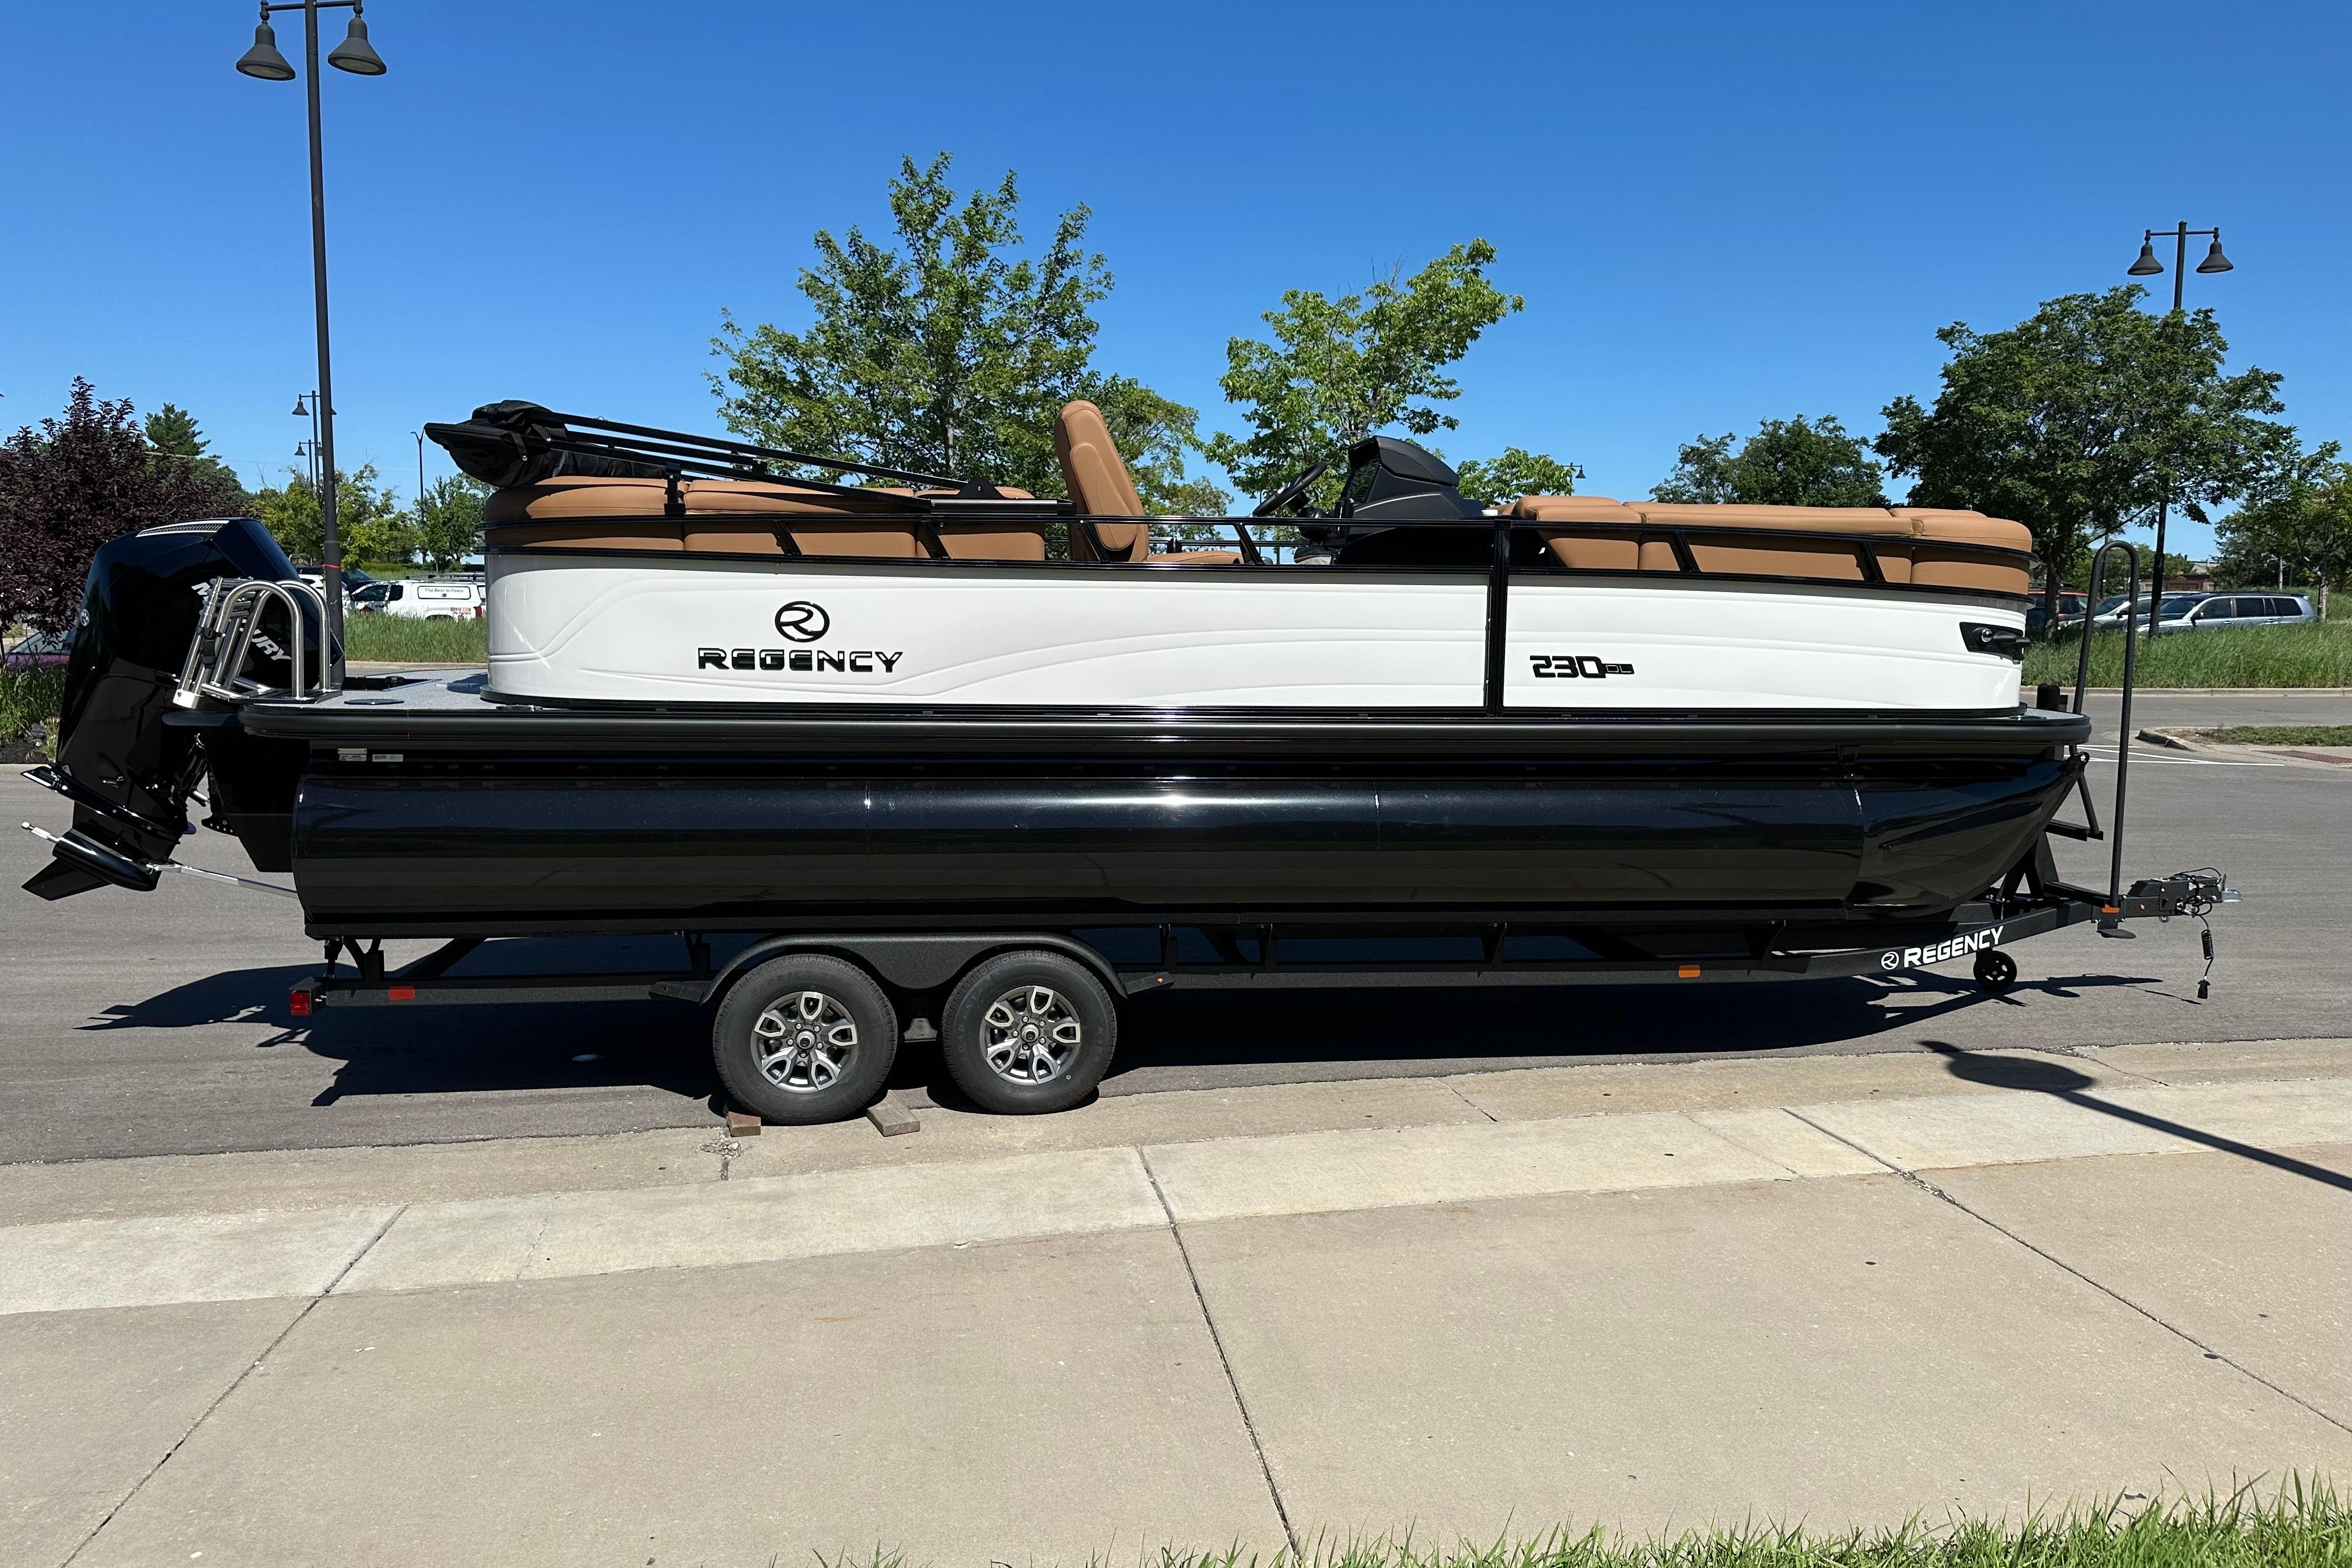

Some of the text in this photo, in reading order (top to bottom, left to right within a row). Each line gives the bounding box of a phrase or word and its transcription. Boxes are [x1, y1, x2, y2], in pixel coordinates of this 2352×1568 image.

[698, 648, 903, 673] REGENCY
[1530, 655, 1633, 678] 230 DL
[1904, 926, 2004, 968] REGENCY
